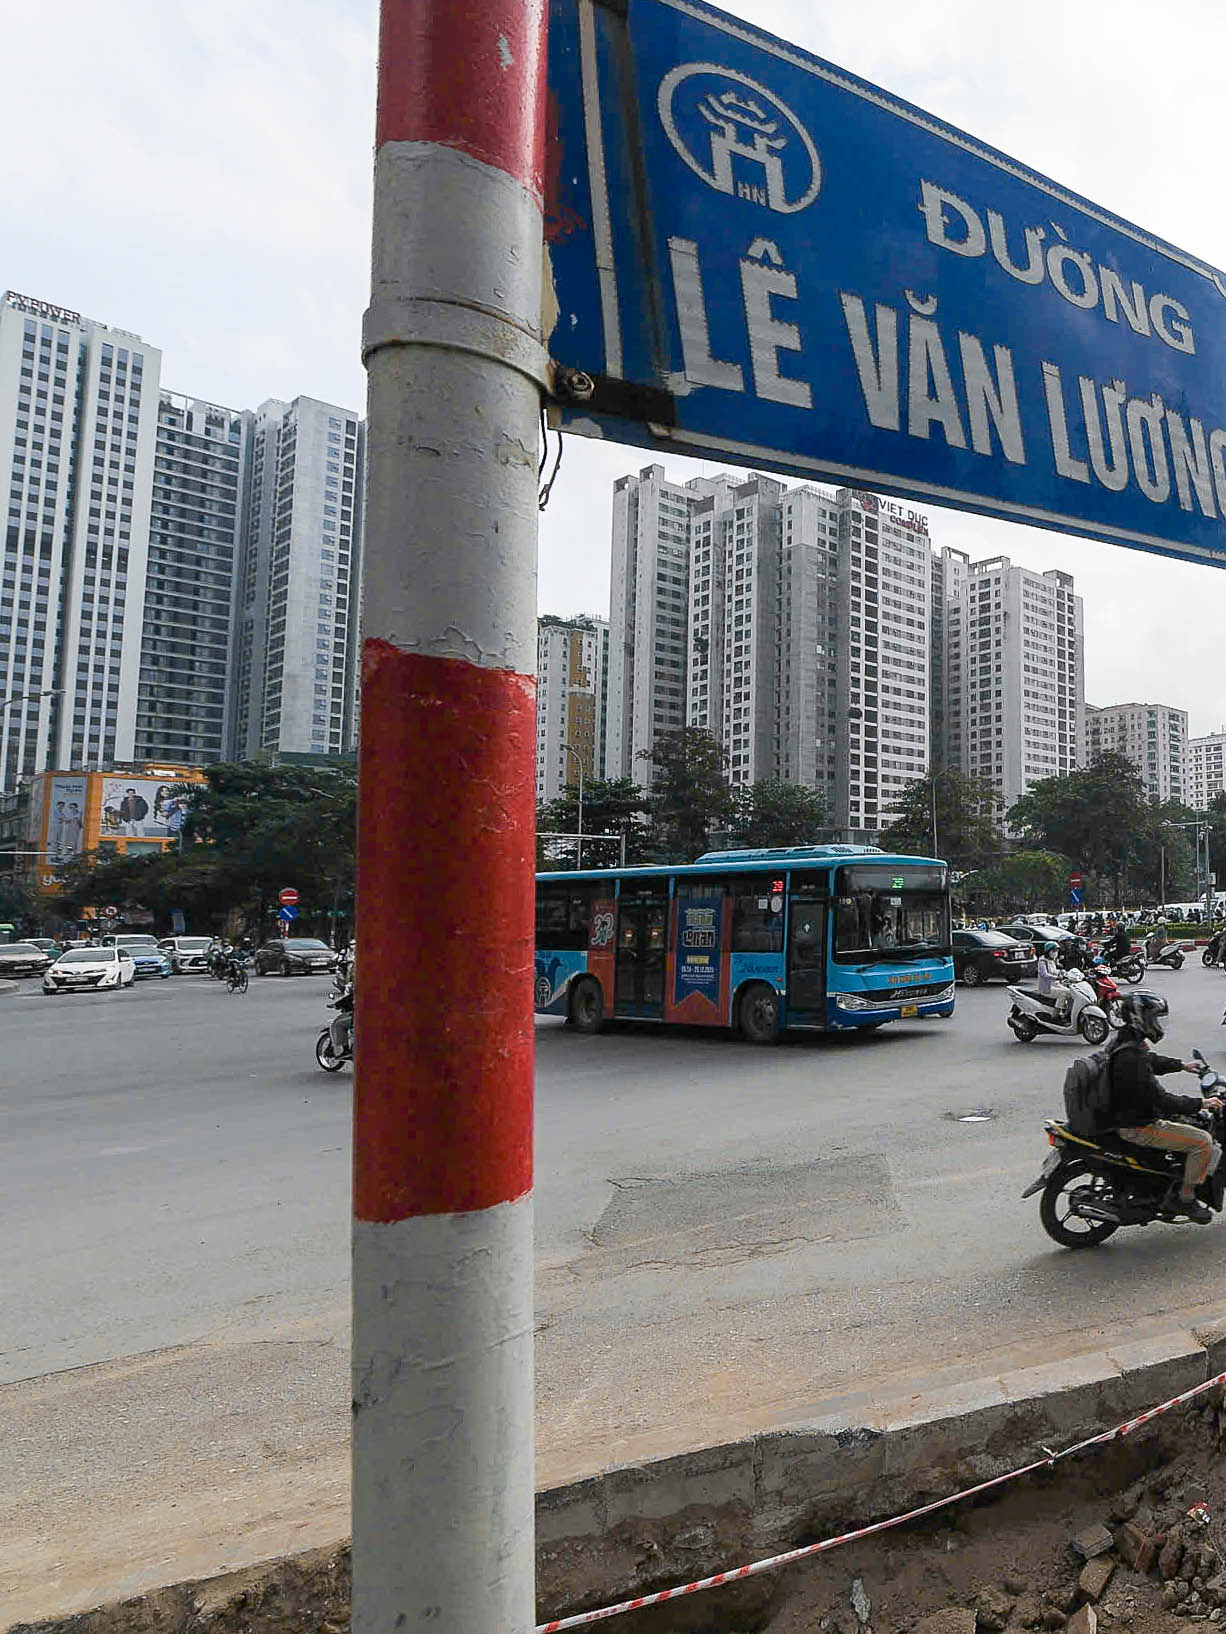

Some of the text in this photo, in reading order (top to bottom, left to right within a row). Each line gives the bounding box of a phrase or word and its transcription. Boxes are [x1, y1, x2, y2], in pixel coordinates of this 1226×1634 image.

[737, 180, 767, 207] HN
[919, 178, 1197, 355] ĐƯỜNG
[667, 237, 813, 410] LÊ
[841, 289, 1026, 465] VĂN
